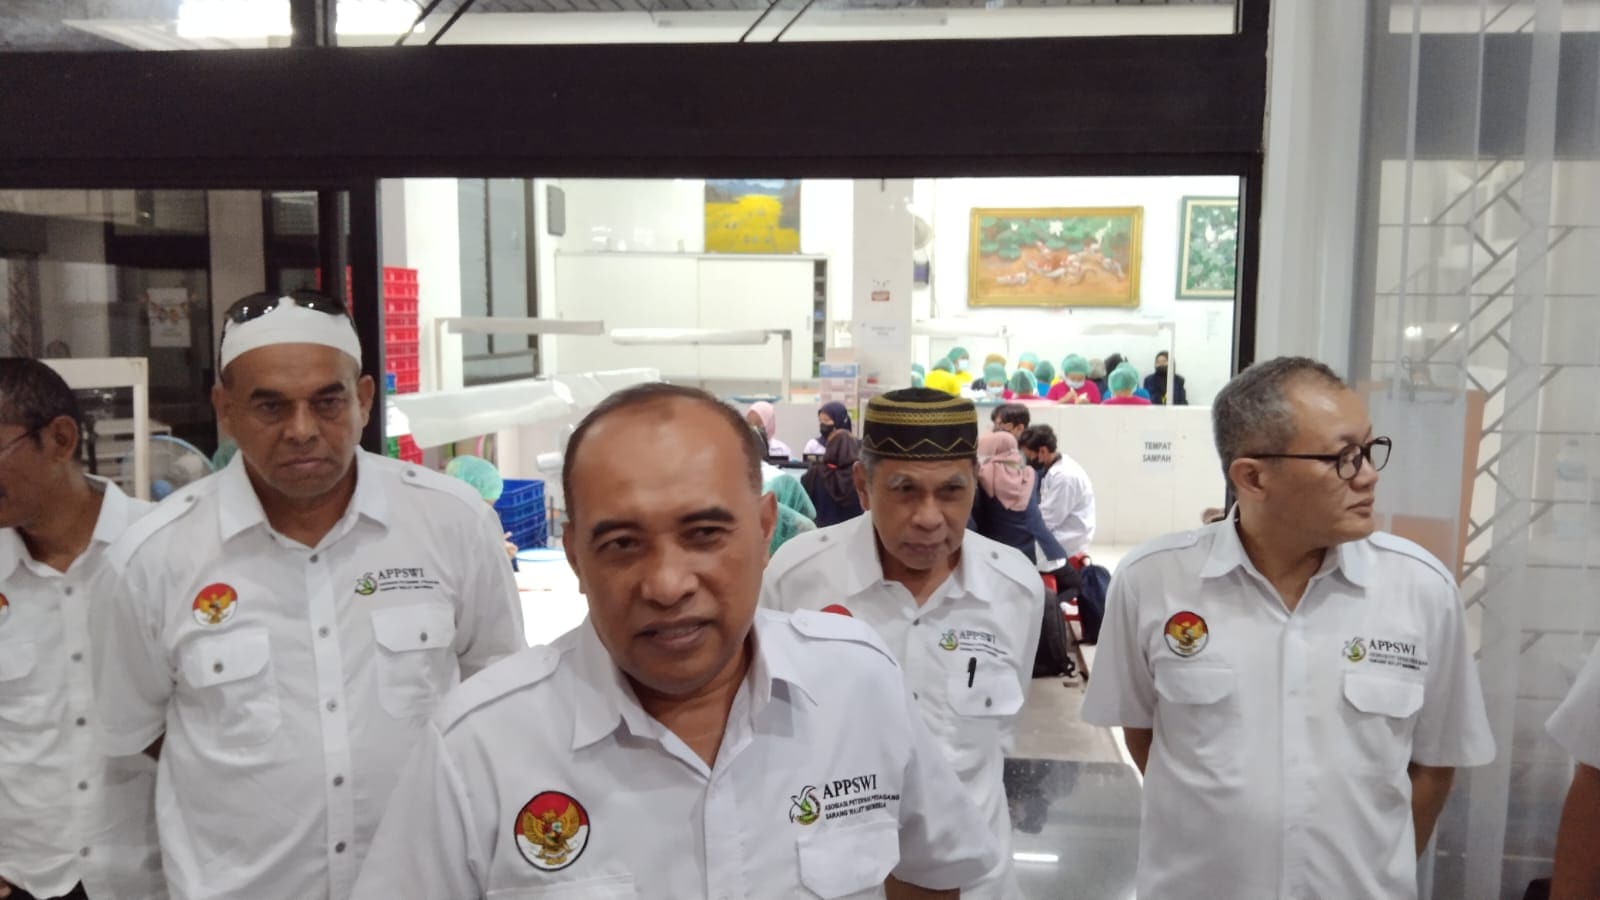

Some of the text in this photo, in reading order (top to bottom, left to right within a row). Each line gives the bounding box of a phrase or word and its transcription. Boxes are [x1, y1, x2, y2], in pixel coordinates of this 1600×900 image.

[1145, 441, 1172, 450] TEMPAT
[1142, 454, 1172, 463] SAMPAH
[378, 567, 425, 580] APPSWI
[1368, 639, 1416, 656] APPSWI
[823, 774, 877, 799] APPSWI
